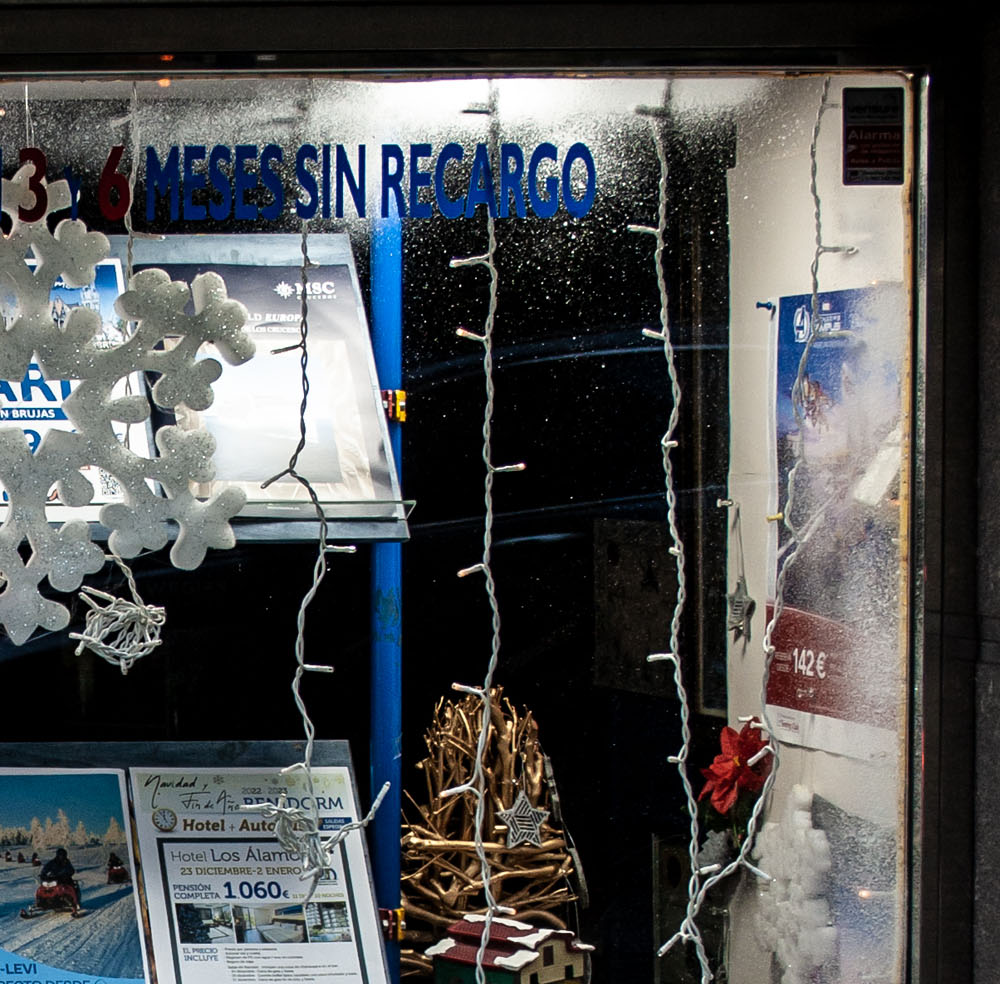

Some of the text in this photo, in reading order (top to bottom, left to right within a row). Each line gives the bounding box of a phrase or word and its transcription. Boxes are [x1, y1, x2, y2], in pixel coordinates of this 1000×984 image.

[847, 130, 901, 141] Alarma
[18, 147, 48, 223] 3
[100, 145, 130, 221] 6
[145, 144, 285, 223] MESES
[299, 143, 367, 219] SIN
[382, 141, 596, 219] RECARGO
[295, 281, 335, 295] MSC
[11, 409, 56, 419] BRUJAS
[144, 775, 198, 808] Navidad
[183, 819, 225, 832] Hotel
[171, 846, 301, 863] Hotel Los Álamo
[180, 867, 193, 876] 23
[266, 866, 301, 875] ENERO
[173, 883, 211, 892] PENSIÓN
[174, 892, 220, 900] COMPLETA
[184, 954, 219, 962] INCLUYE
